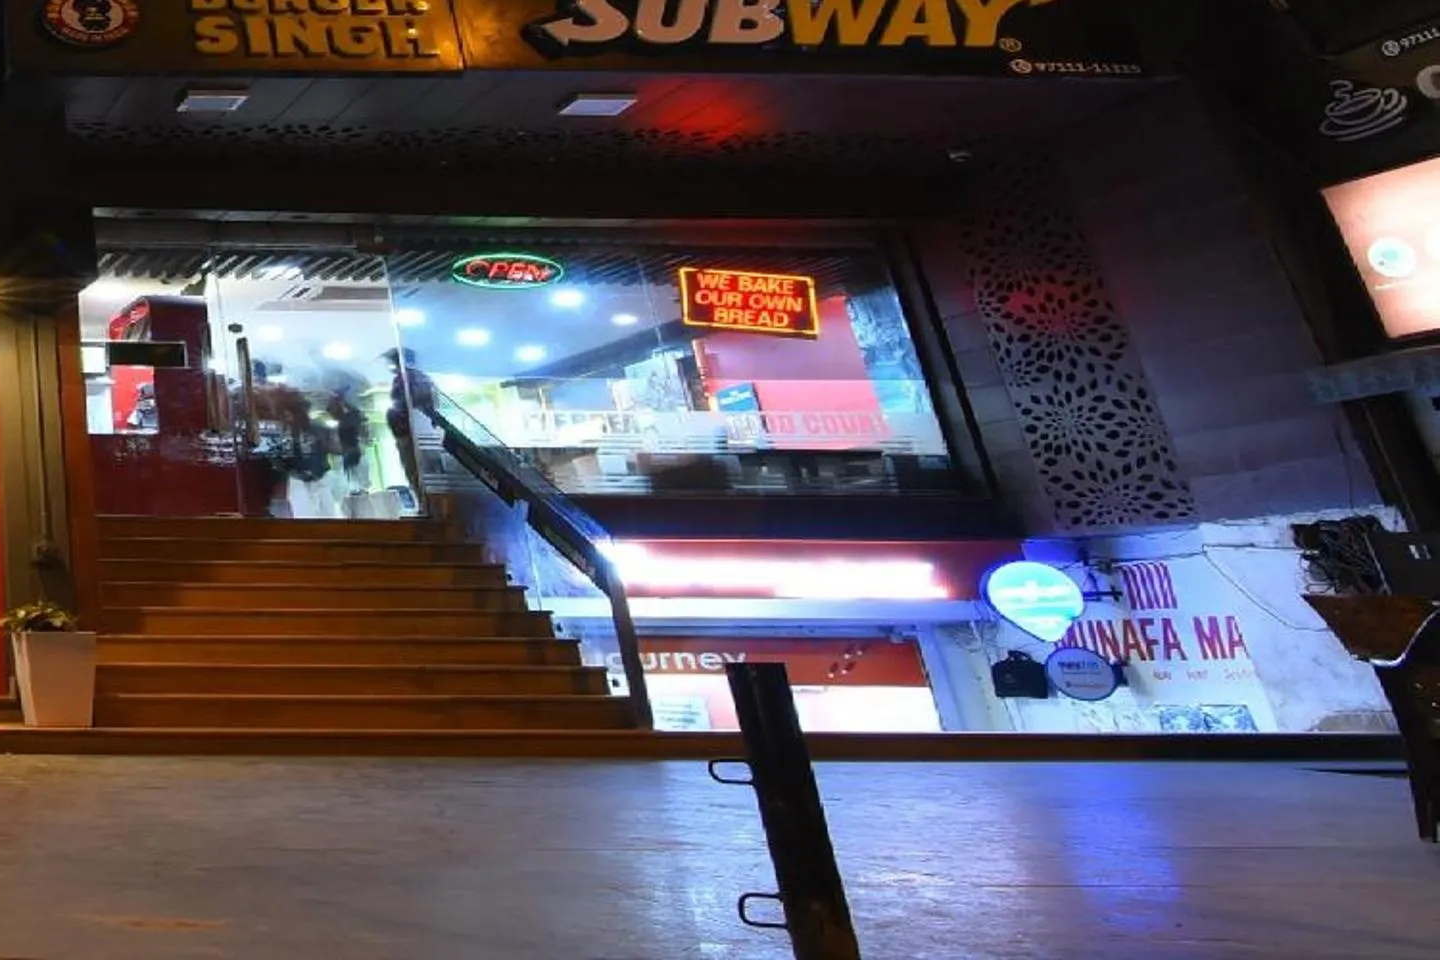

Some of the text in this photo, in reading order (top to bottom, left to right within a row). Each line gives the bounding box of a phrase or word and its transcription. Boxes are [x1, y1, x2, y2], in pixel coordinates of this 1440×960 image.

[194, 16, 441, 60] SINGH
[696, 271, 794, 295] WE BAKE
[694, 288, 803, 313] OUR OWN
[713, 306, 790, 328] BREAD
